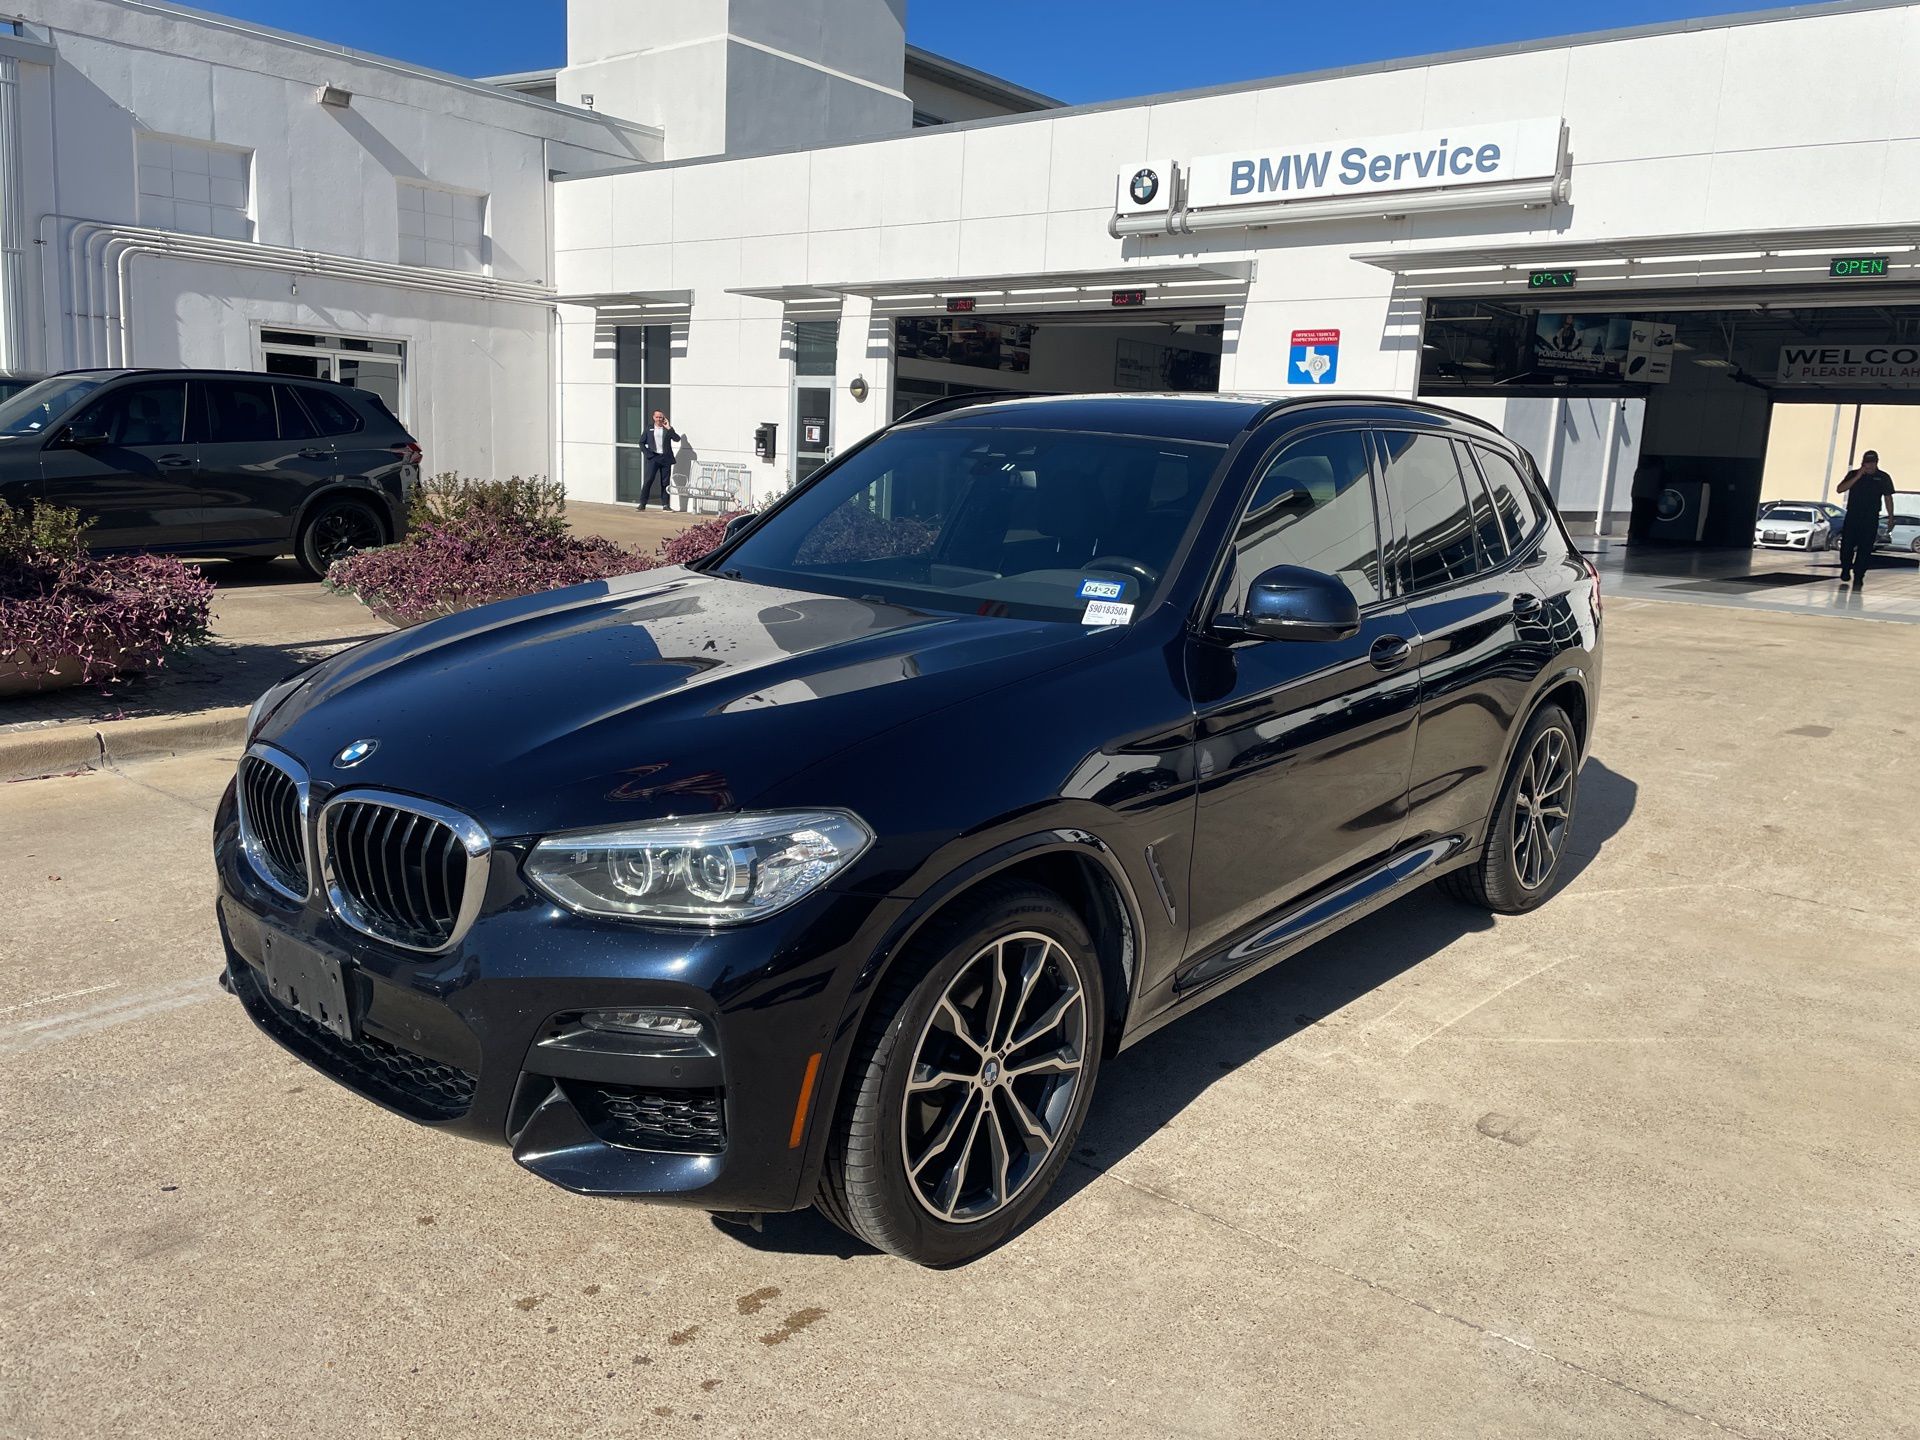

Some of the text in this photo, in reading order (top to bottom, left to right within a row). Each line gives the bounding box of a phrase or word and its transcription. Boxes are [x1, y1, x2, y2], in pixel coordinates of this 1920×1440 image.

[1230, 138, 1501, 195] BMW Service
[1836, 259, 1883, 274] OPEN
[1785, 349, 1918, 365] WELCO
[1802, 367, 1857, 377] PLEASE
[1860, 367, 1897, 377] PULL
